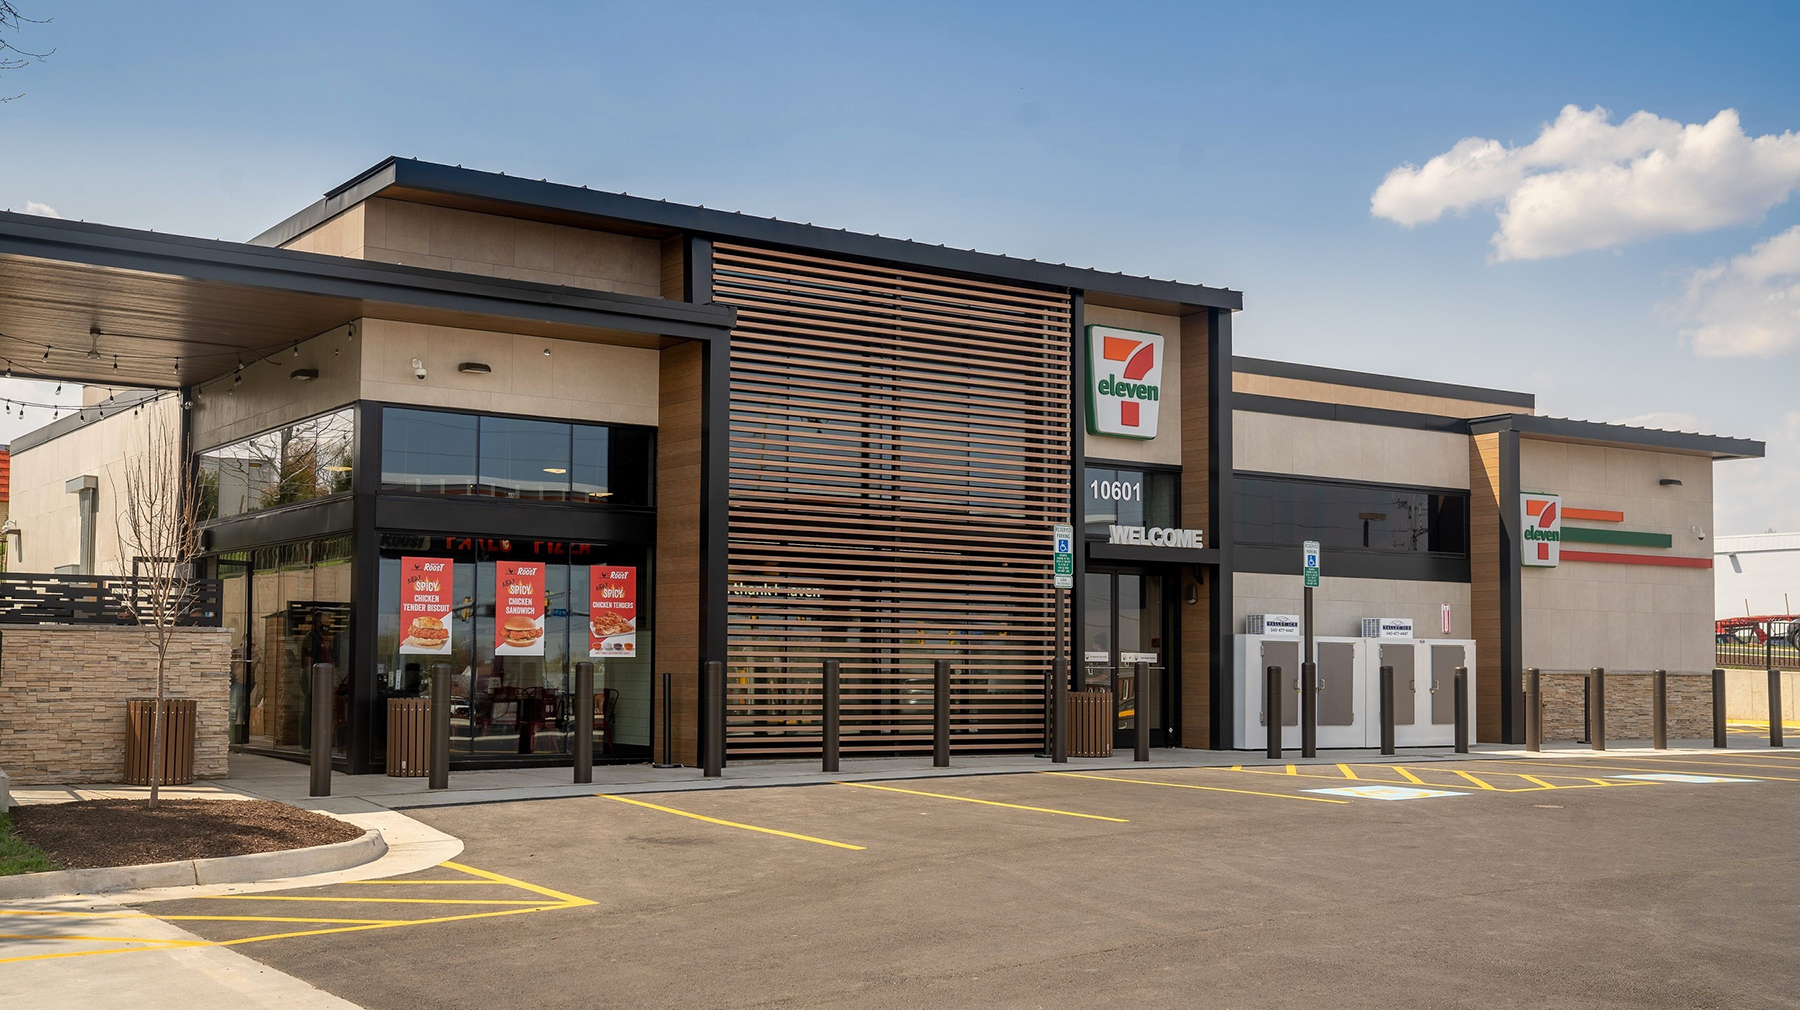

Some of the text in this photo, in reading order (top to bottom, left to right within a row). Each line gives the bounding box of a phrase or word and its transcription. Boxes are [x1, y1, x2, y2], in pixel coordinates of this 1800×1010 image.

[1103, 336, 1154, 427] 7
[1098, 374, 1159, 401] eleven
[1090, 480, 1140, 501] 10601
[1524, 525, 1559, 541] eleven
[1526, 499, 1556, 560] 7
[1109, 525, 1203, 549] WELCOME
[416, 581, 438, 592] SPICY
[510, 585, 532, 595] SPICY
[414, 594, 440, 602] CHICKEN
[603, 588, 623, 598] SPICY
[508, 597, 533, 606] CHICKEN
[403, 603, 450, 612] TENDER BISCUIT
[505, 606, 535, 615] SANDWICH
